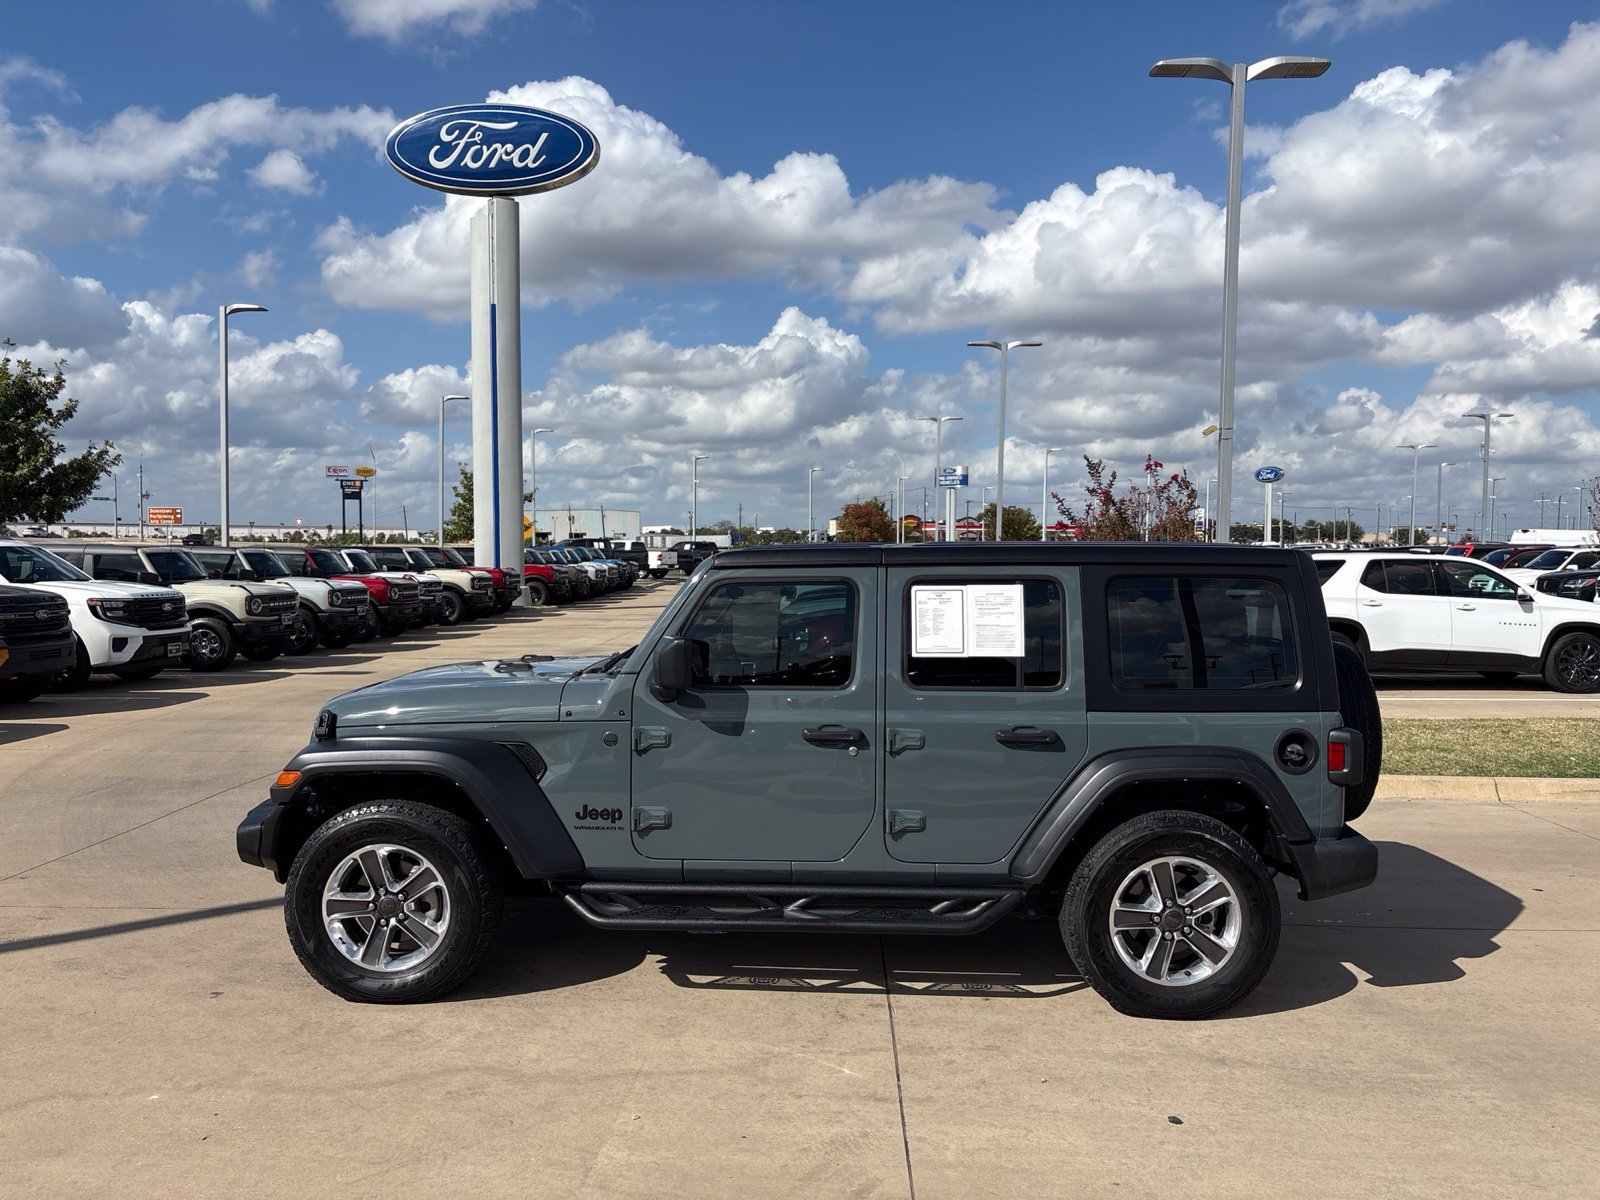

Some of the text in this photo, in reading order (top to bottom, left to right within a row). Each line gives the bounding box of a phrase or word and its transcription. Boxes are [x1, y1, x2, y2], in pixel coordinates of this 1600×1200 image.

[428, 119, 549, 169] Ford
[327, 467, 348, 475] Exxon
[1258, 469, 1276, 480] Ford
[574, 804, 623, 824] Jeep
